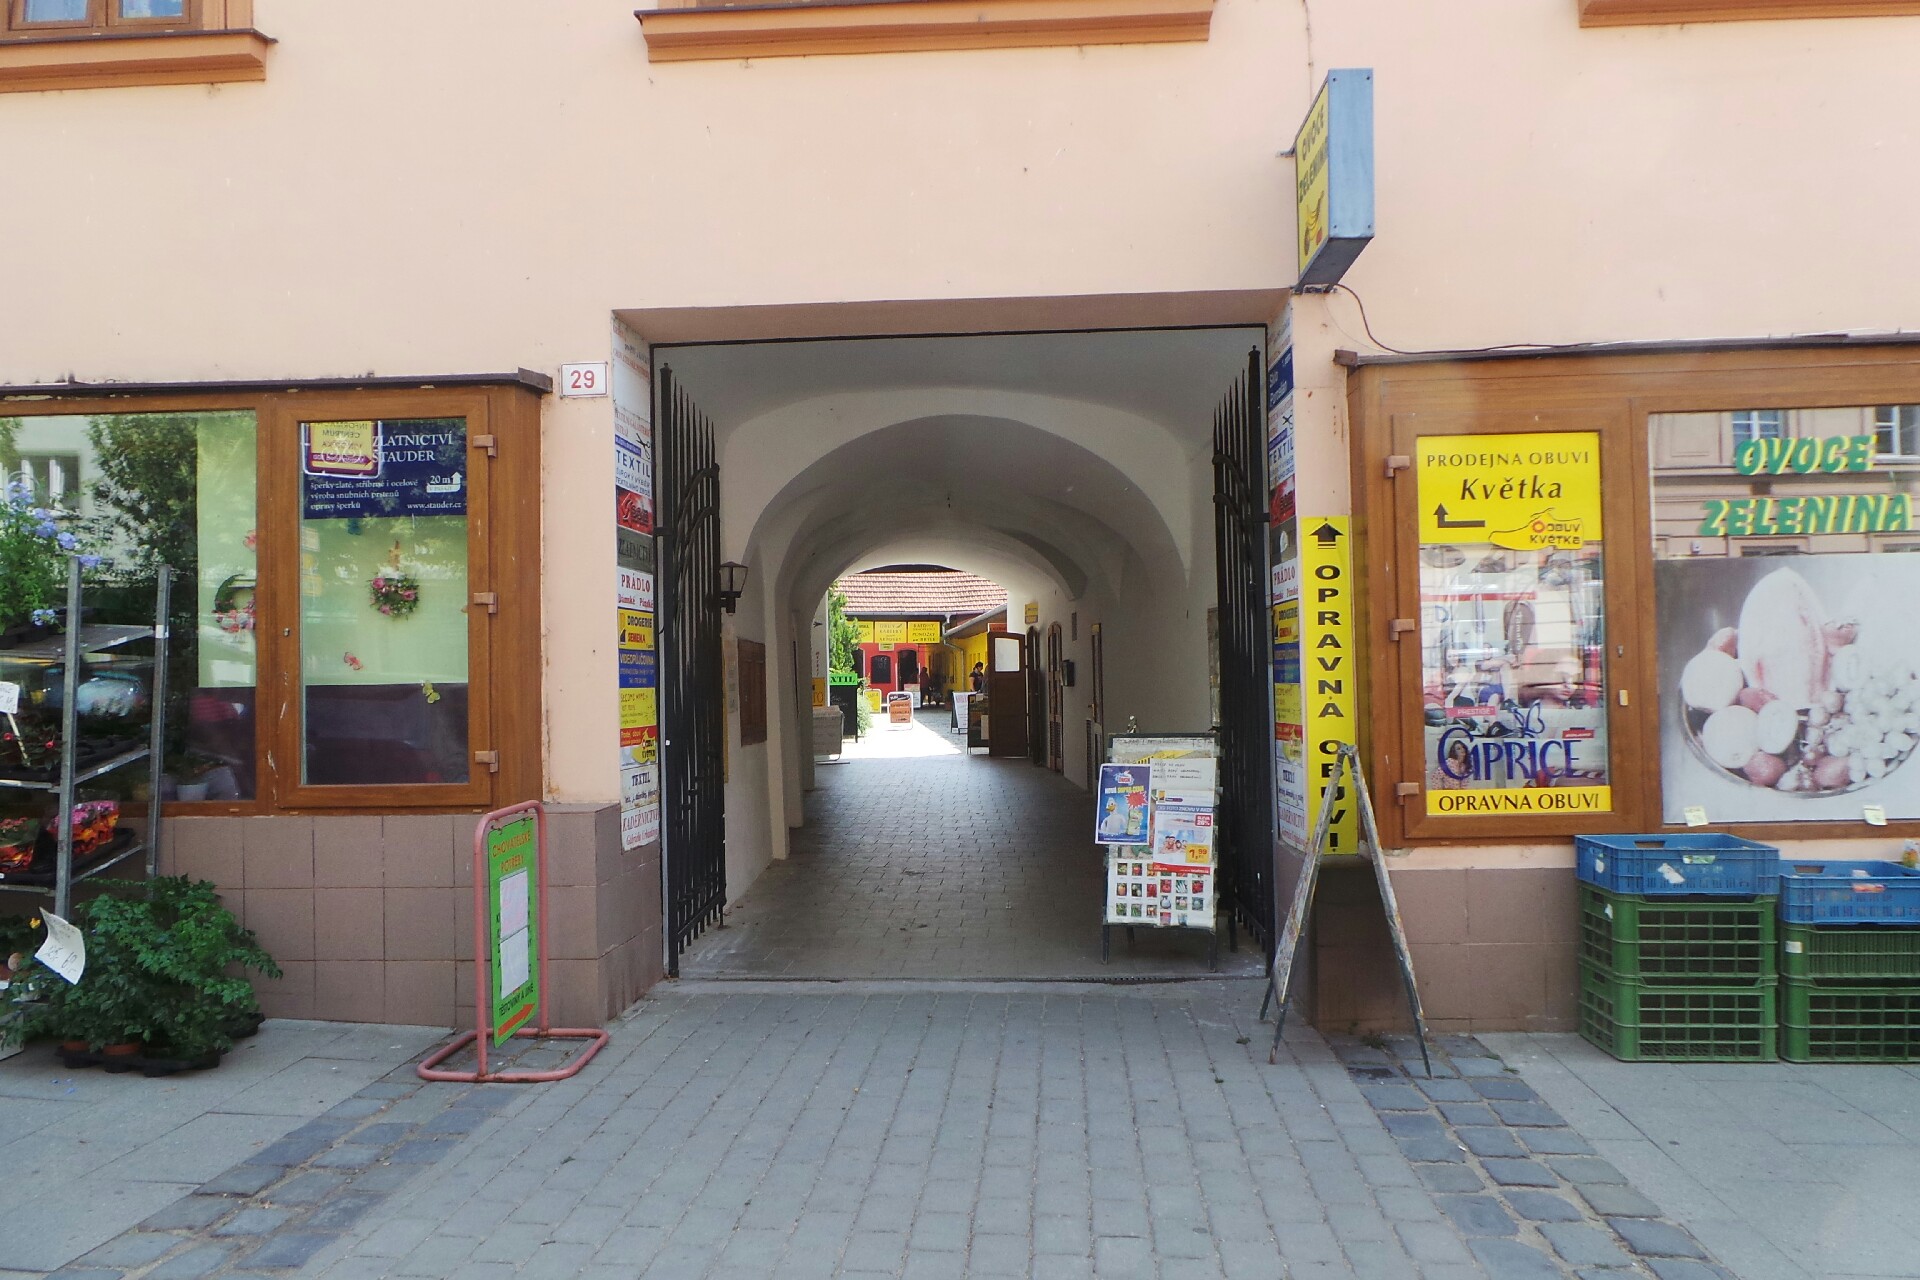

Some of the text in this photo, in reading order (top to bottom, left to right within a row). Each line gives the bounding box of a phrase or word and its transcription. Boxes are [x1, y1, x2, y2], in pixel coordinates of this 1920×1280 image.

[571, 370, 594, 388] 29
[372, 430, 454, 447] ZLATNICTVÍ
[372, 451, 435, 463] STAUDER
[615, 449, 650, 478] TEXTIL
[1427, 451, 1589, 467] PRODEJNA OBUVI
[1736, 435, 1878, 475] OVOCE
[391, 479, 418, 487] ocelové
[430, 475, 450, 484] 20 m
[1461, 475, 1561, 500] Květka
[310, 491, 335, 500] výroba
[336, 491, 370, 499] snubních
[336, 501, 361, 510] šperků
[407, 502, 462, 510] www.stauder.cz
[1699, 493, 1913, 536] ZELENINA
[621, 573, 651, 592] PRÁDLO
[627, 615, 652, 628] DROGERIE
[1314, 565, 1344, 718] OPRAVNA
[1439, 793, 1599, 811] OPRAVNA OBUVI
